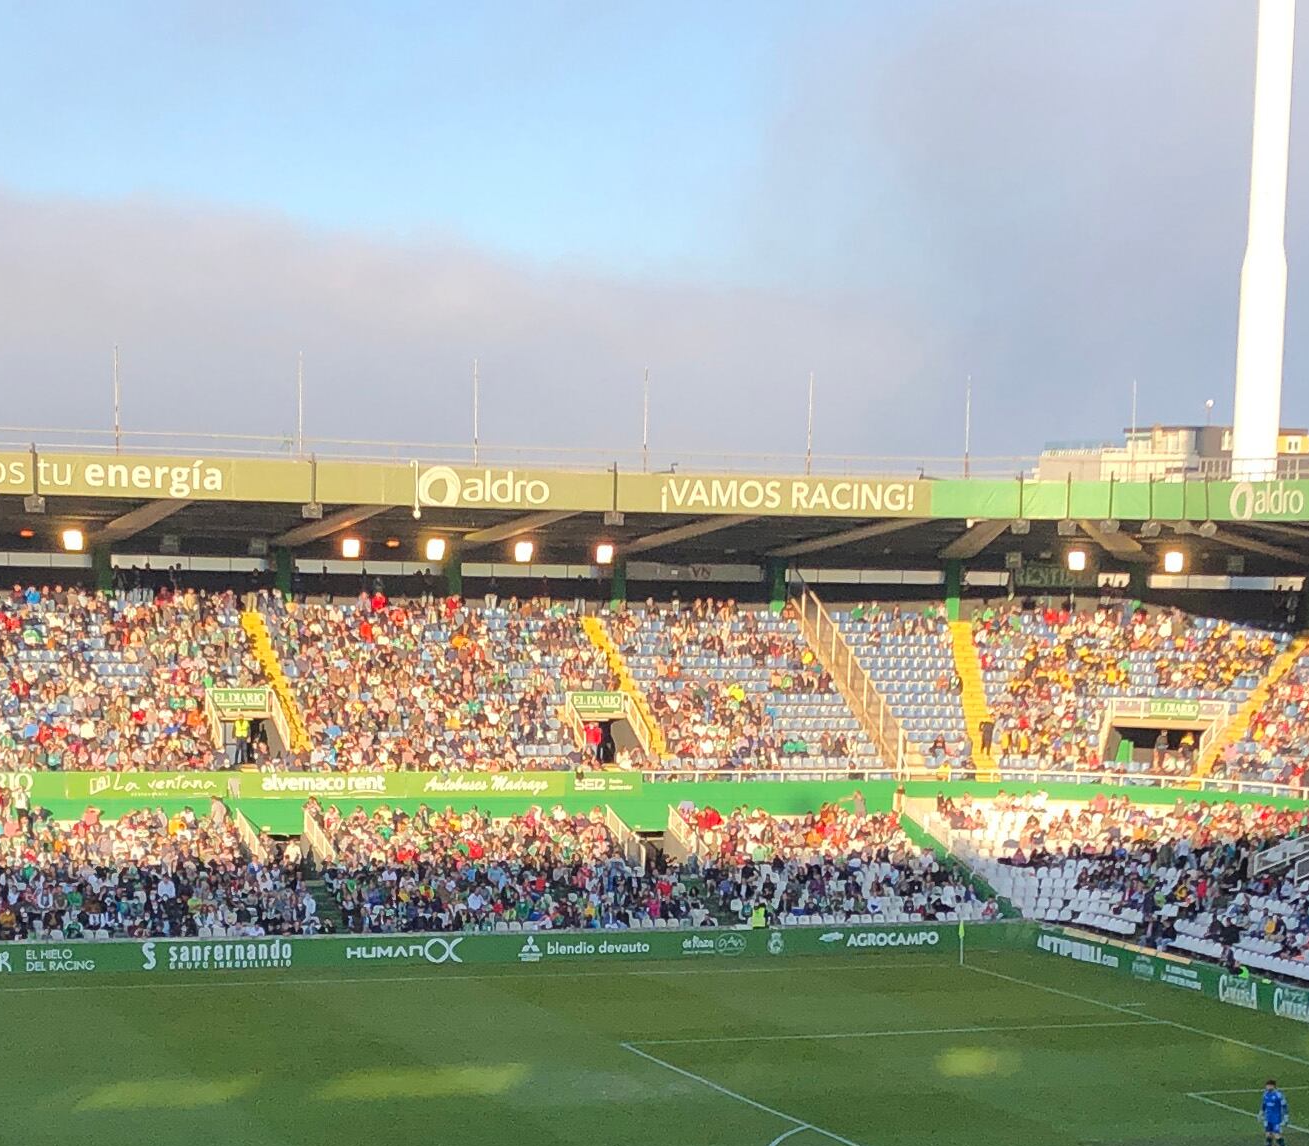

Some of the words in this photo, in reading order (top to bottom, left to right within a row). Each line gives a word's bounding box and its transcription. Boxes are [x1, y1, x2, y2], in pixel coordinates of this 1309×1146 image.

[38, 456, 73, 485] tu
[85, 459, 223, 499] energía
[463, 469, 550, 505] aldro
[660, 478, 781, 513] ¡VAMOS
[791, 481, 915, 512] RACING!
[1254, 481, 1305, 515] aldro
[228, 692, 266, 703] DIARIO
[586, 695, 620, 706] DIARIO
[113, 773, 140, 792] La
[148, 775, 217, 791] ventana
[262, 774, 346, 791] alvemaco
[347, 775, 386, 791] rent
[847, 931, 939, 947] AGROCAMPO
[26, 950, 38, 960] EL
[41, 949, 73, 960] HIELO
[598, 940, 650, 955] devauto
[26, 961, 46, 972] DEL
[49, 960, 96, 971] RACING
